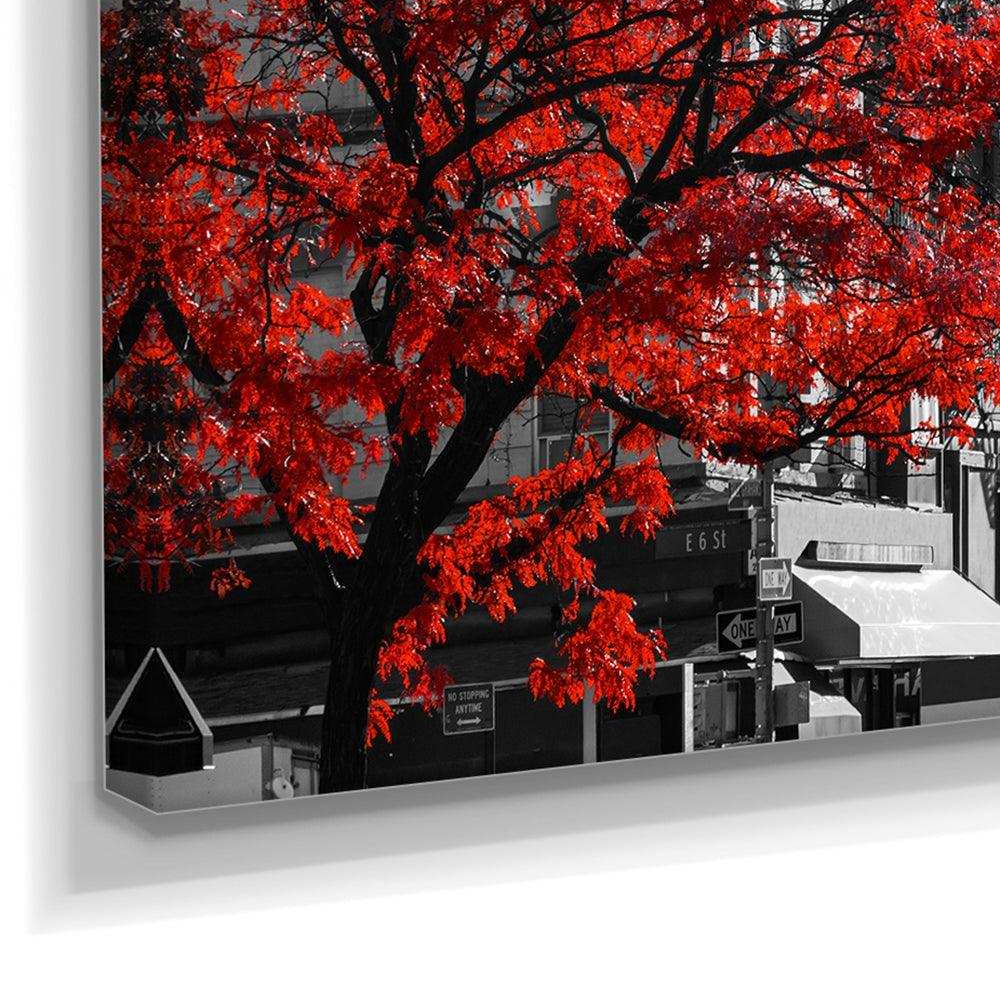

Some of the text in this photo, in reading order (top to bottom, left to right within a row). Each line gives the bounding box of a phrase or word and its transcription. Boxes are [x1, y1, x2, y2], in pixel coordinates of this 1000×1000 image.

[686, 529, 726, 552] E 6 St
[730, 616, 791, 639] ONE AY
[448, 689, 489, 701] NO STOPPING
[455, 702, 482, 714] ANYTIME
